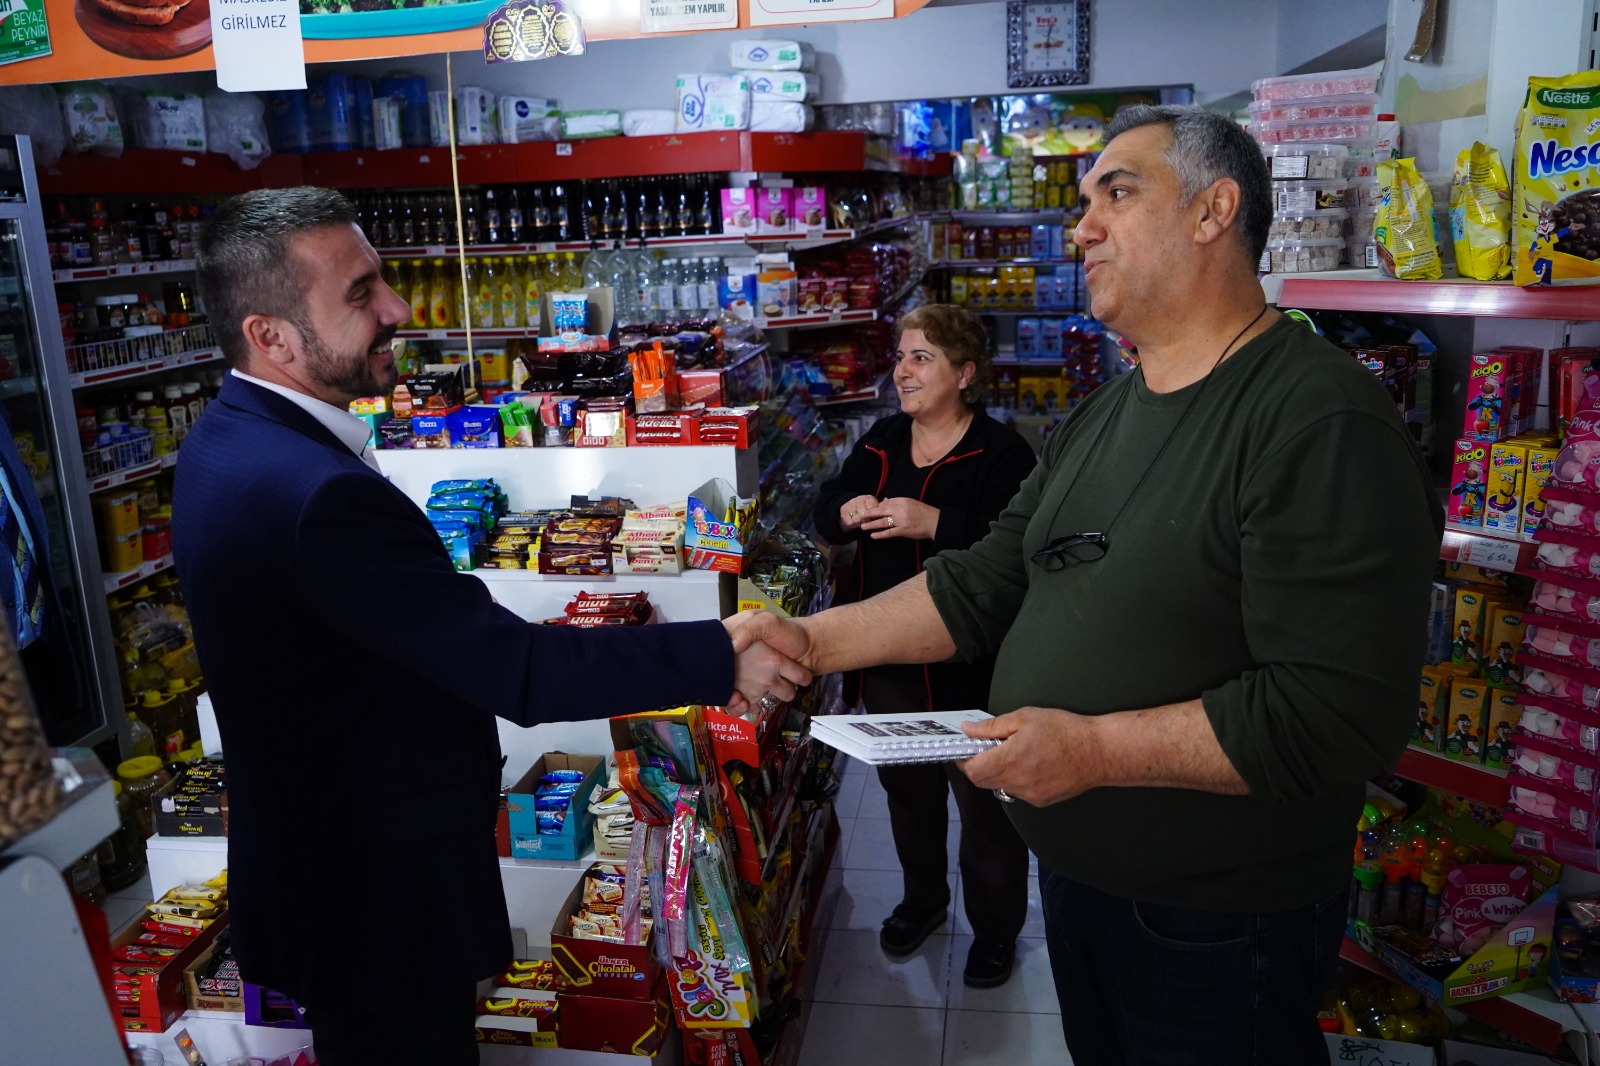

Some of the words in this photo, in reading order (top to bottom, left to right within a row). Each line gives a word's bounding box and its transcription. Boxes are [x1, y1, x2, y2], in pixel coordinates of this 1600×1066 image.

[13, 9, 45, 26] BEYAZ
[221, 13, 287, 30] GİRİLMEZ
[11, 23, 47, 42] PEYNİR
[636, 420, 674, 428] adelle
[1570, 416, 1593, 432] Pink
[637, 511, 671, 519] Albeni
[1465, 883, 1510, 896] BEBETO
[1455, 908, 1482, 920] Pink
[598, 955, 629, 966] ÜLKER
